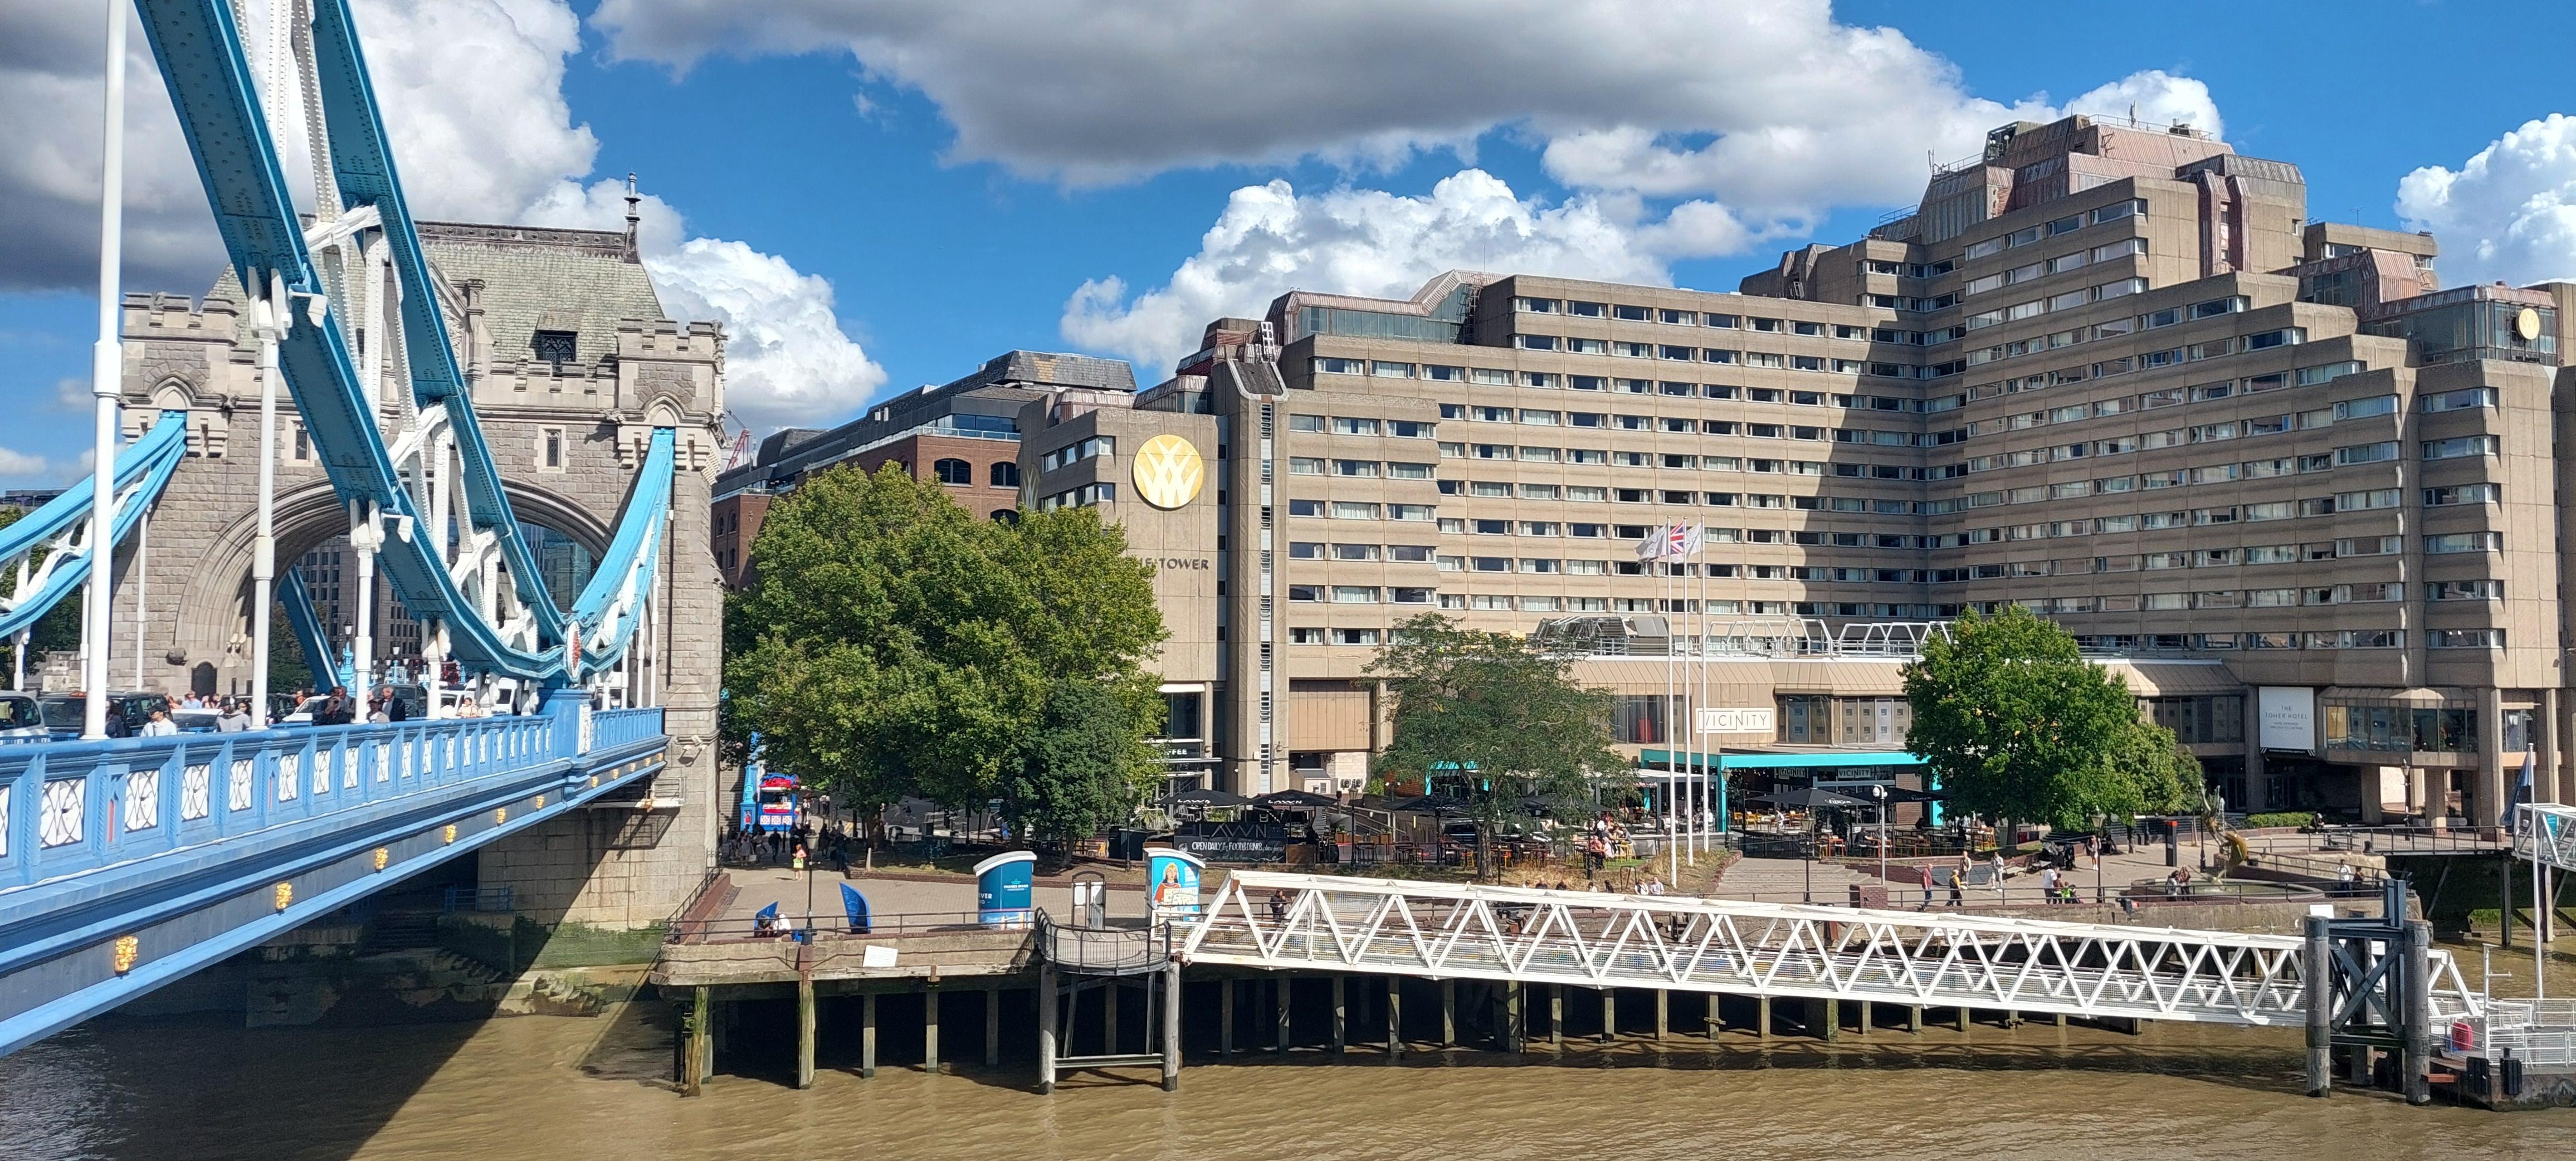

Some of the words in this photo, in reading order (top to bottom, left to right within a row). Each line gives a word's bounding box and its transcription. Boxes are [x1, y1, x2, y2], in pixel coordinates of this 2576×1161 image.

[1159, 558, 1208, 570] TOWER
[1839, 769, 1869, 778] VICINITY
[1199, 823, 1266, 838] LAWN
[1192, 842, 1207, 851] OPEN
[1208, 842, 1221, 851] DAILY
